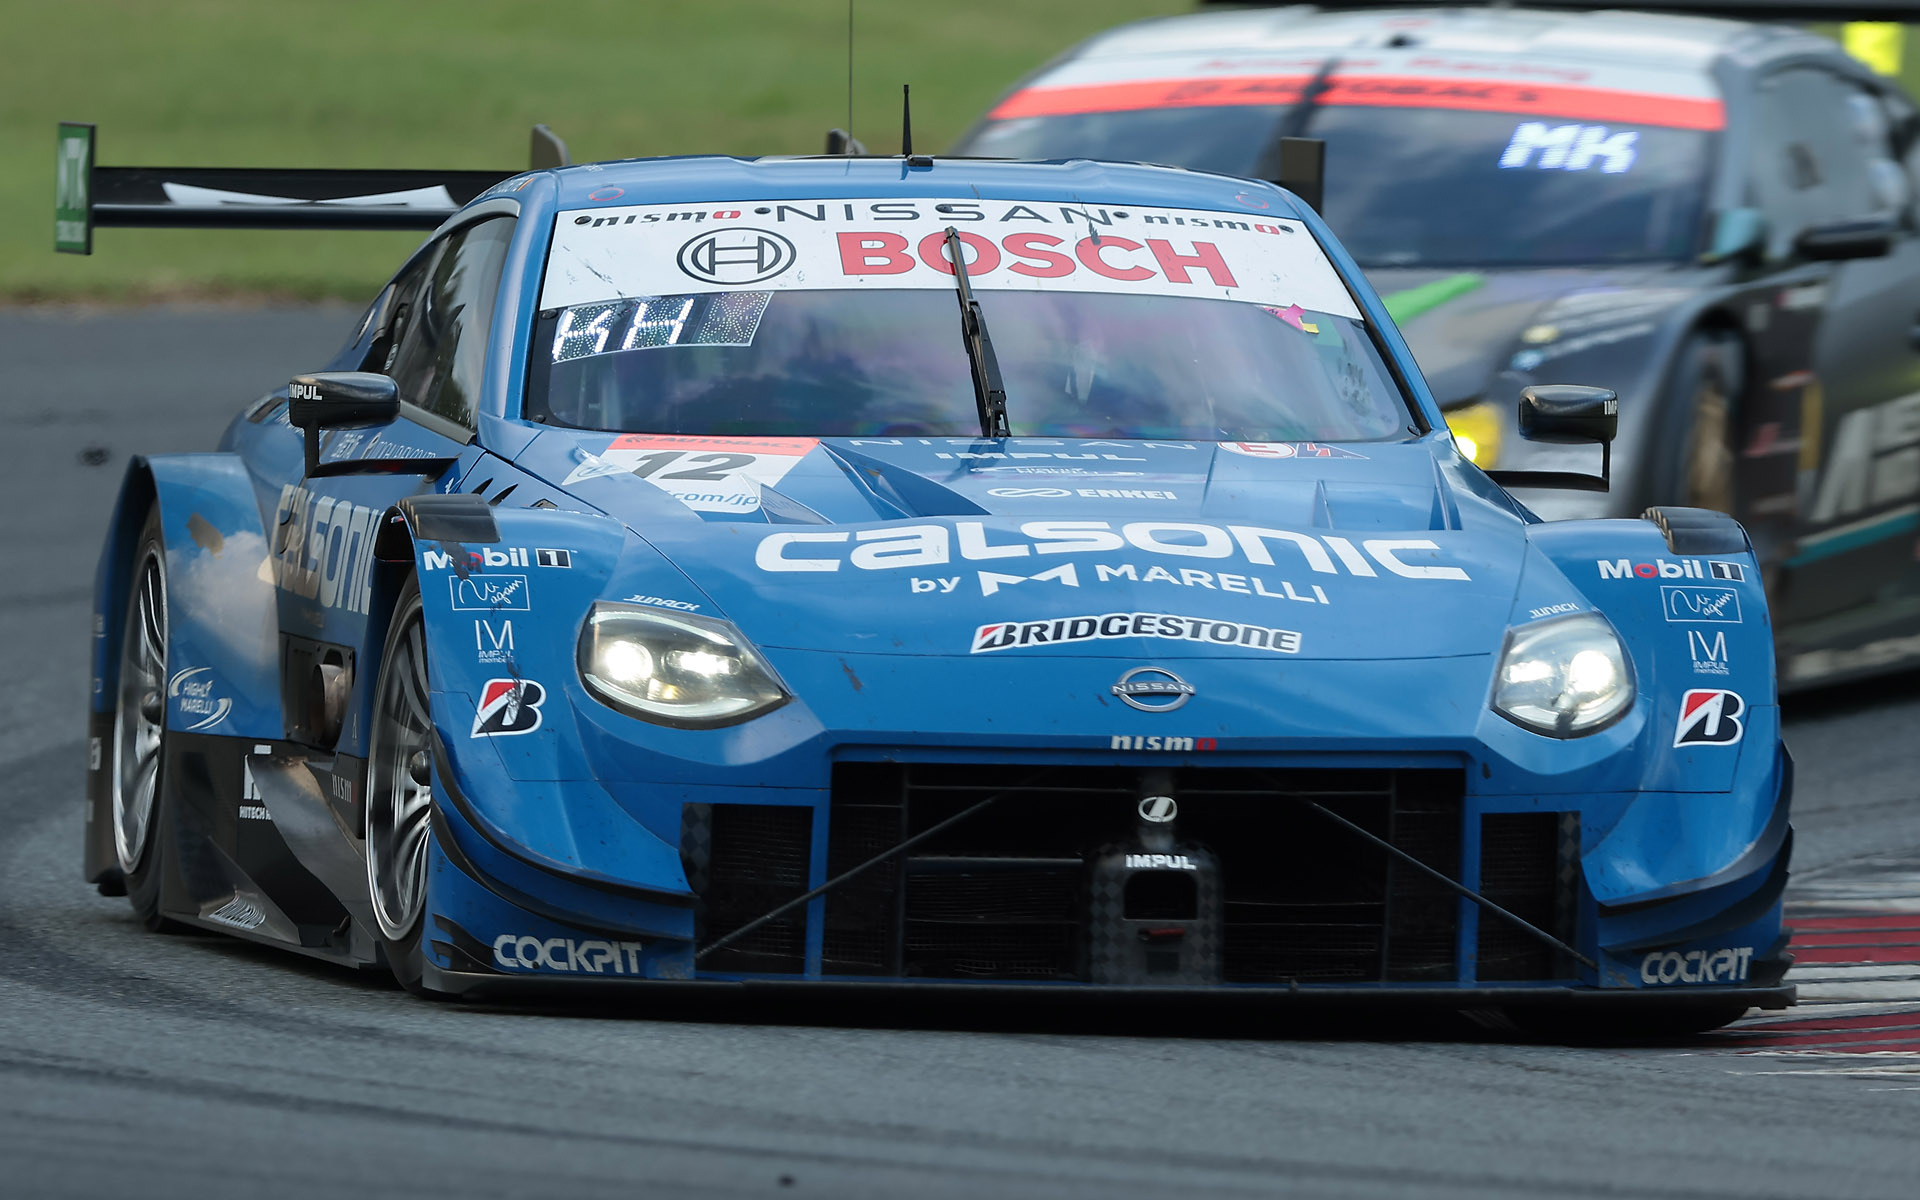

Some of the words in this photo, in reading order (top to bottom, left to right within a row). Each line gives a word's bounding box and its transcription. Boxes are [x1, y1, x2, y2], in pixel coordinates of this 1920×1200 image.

[1499, 122, 1639, 173] MK
[777, 202, 1113, 226] NISSAN
[836, 231, 1239, 288] BOSCH
[289, 383, 323, 400] IMPUL
[848, 439, 1197, 450] NISSAN
[632, 451, 757, 481] 12
[935, 452, 1147, 462] IMPUL
[1076, 488, 1178, 501] ENKEI
[423, 547, 529, 571] Mobil
[1597, 558, 1704, 580] Mobil
[911, 576, 961, 594] by
[1095, 563, 1330, 605] MARELLI
[624, 594, 701, 612] JUNACK
[1530, 602, 1580, 619] JUNACK
[980, 613, 1300, 651] BRIDGESTONE
[1112, 682, 1195, 694] NISSAN
[1125, 854, 1197, 870] IMPUL
[493, 934, 643, 974] COCKPIT
[1640, 947, 1754, 984] COCKPIT
